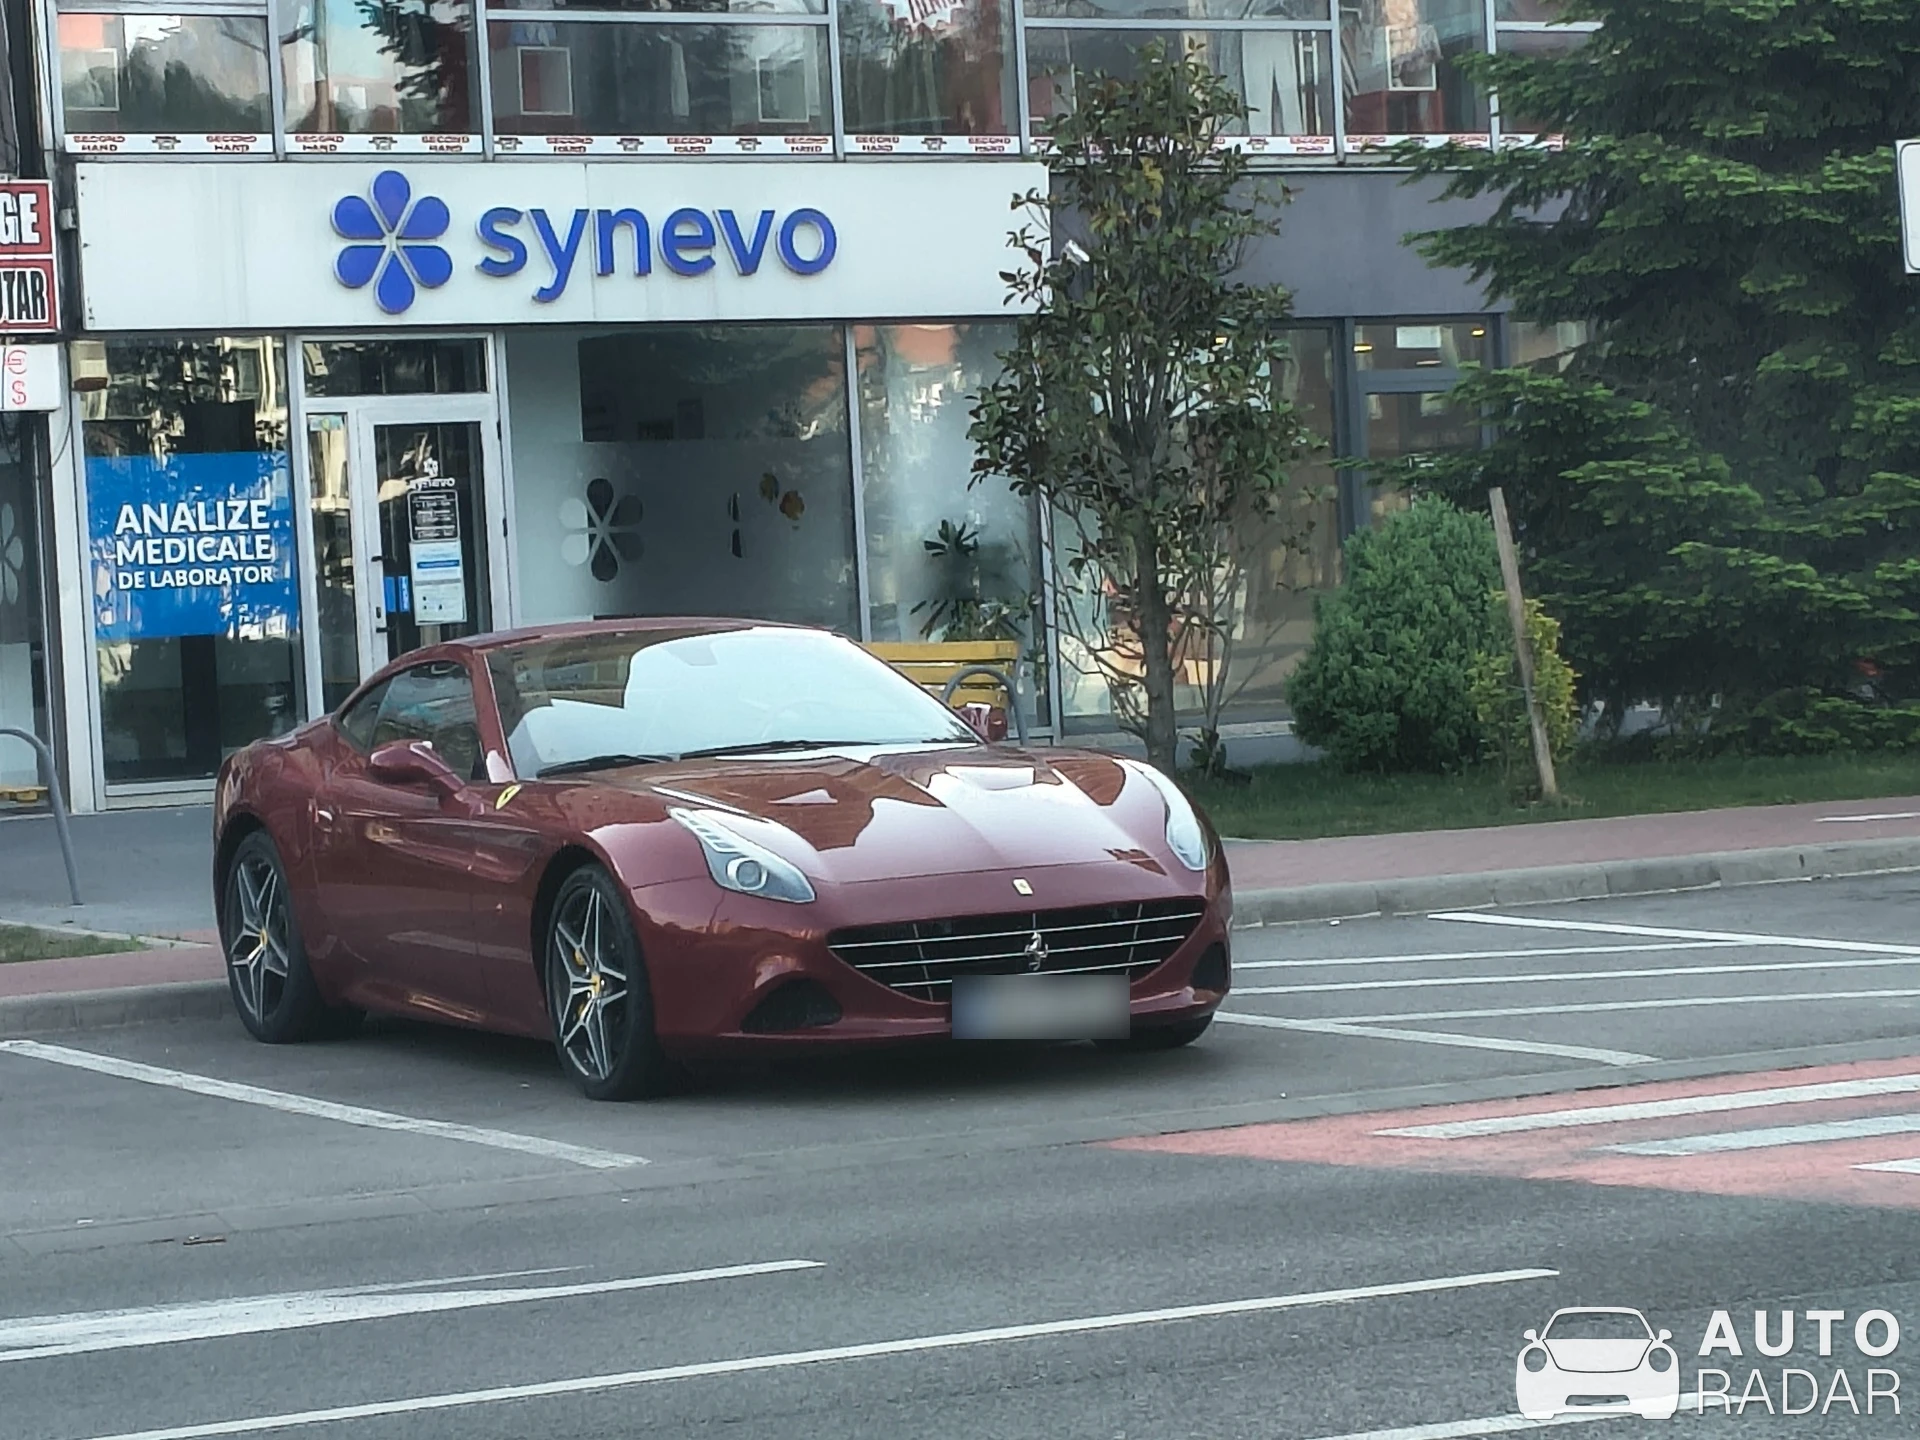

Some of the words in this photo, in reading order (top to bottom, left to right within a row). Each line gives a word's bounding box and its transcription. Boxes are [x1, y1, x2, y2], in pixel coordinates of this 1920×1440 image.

[475, 207, 837, 302] synevo
[0, 270, 46, 320] TAR
[115, 499, 270, 535] ANALIZE
[117, 534, 272, 566] MEDICALE
[118, 571, 145, 589] DE
[150, 566, 273, 587] LABORATOR
